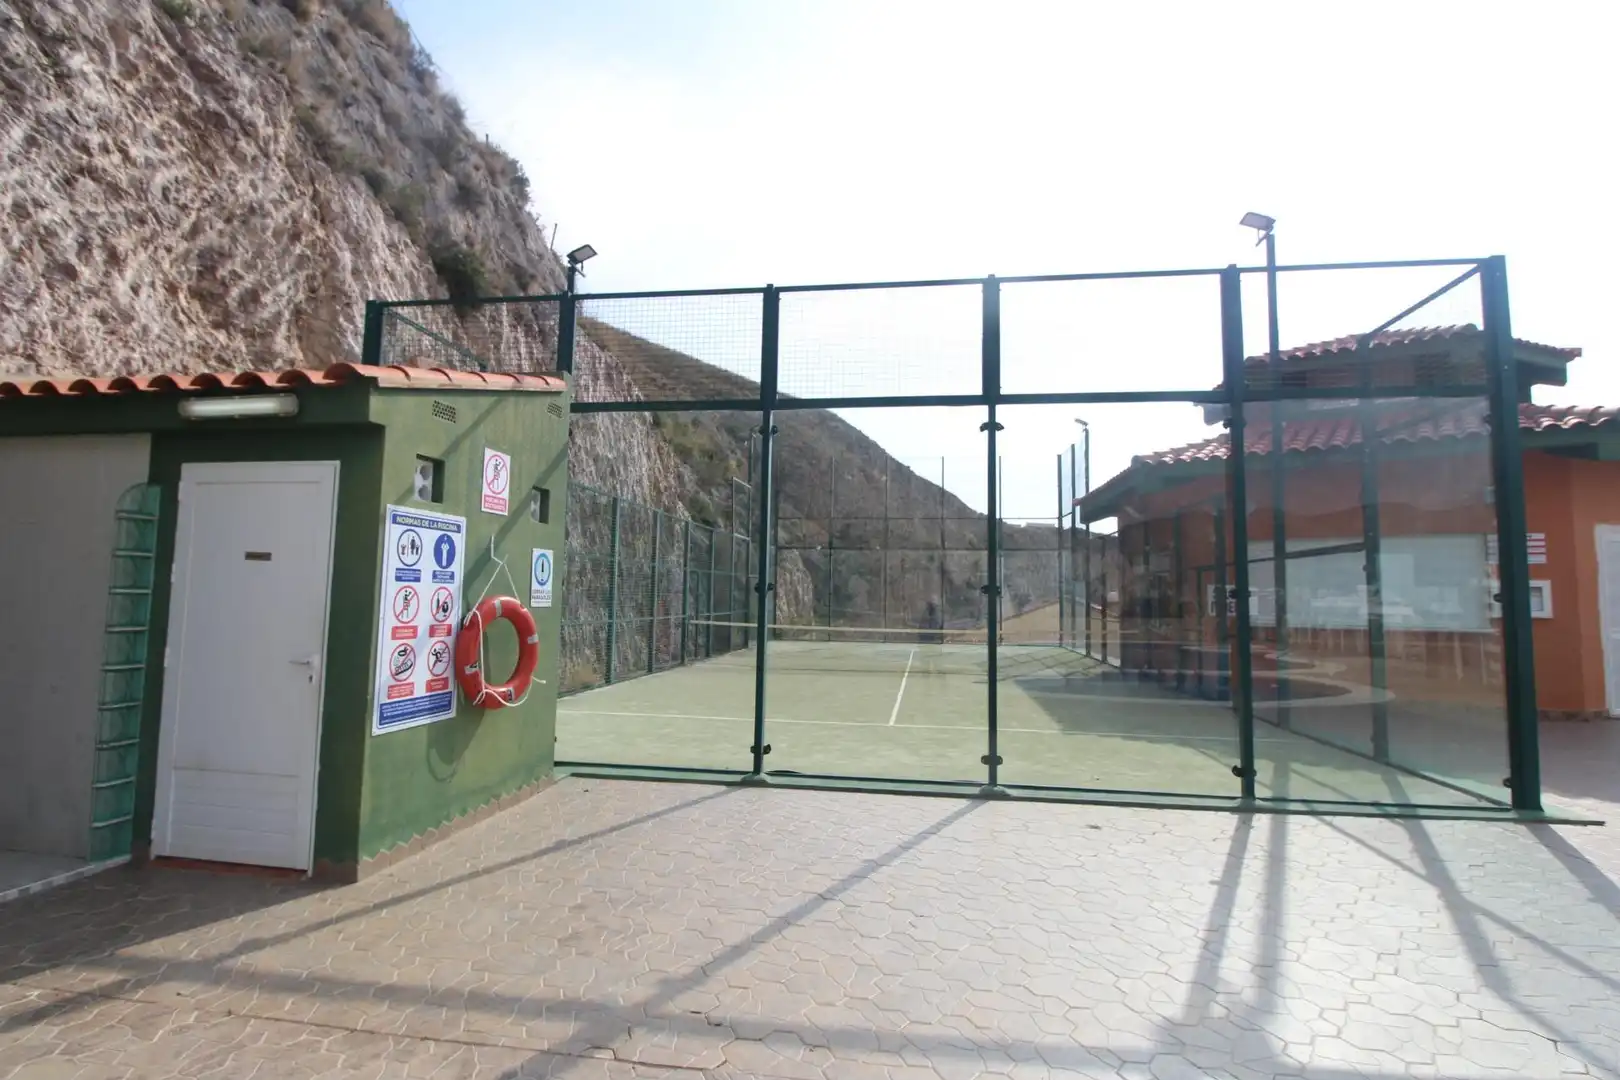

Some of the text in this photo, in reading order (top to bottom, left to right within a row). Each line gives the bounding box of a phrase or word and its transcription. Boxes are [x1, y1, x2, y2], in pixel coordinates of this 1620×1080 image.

[396, 516, 458, 531] NORMAS DE LA PISCINA
